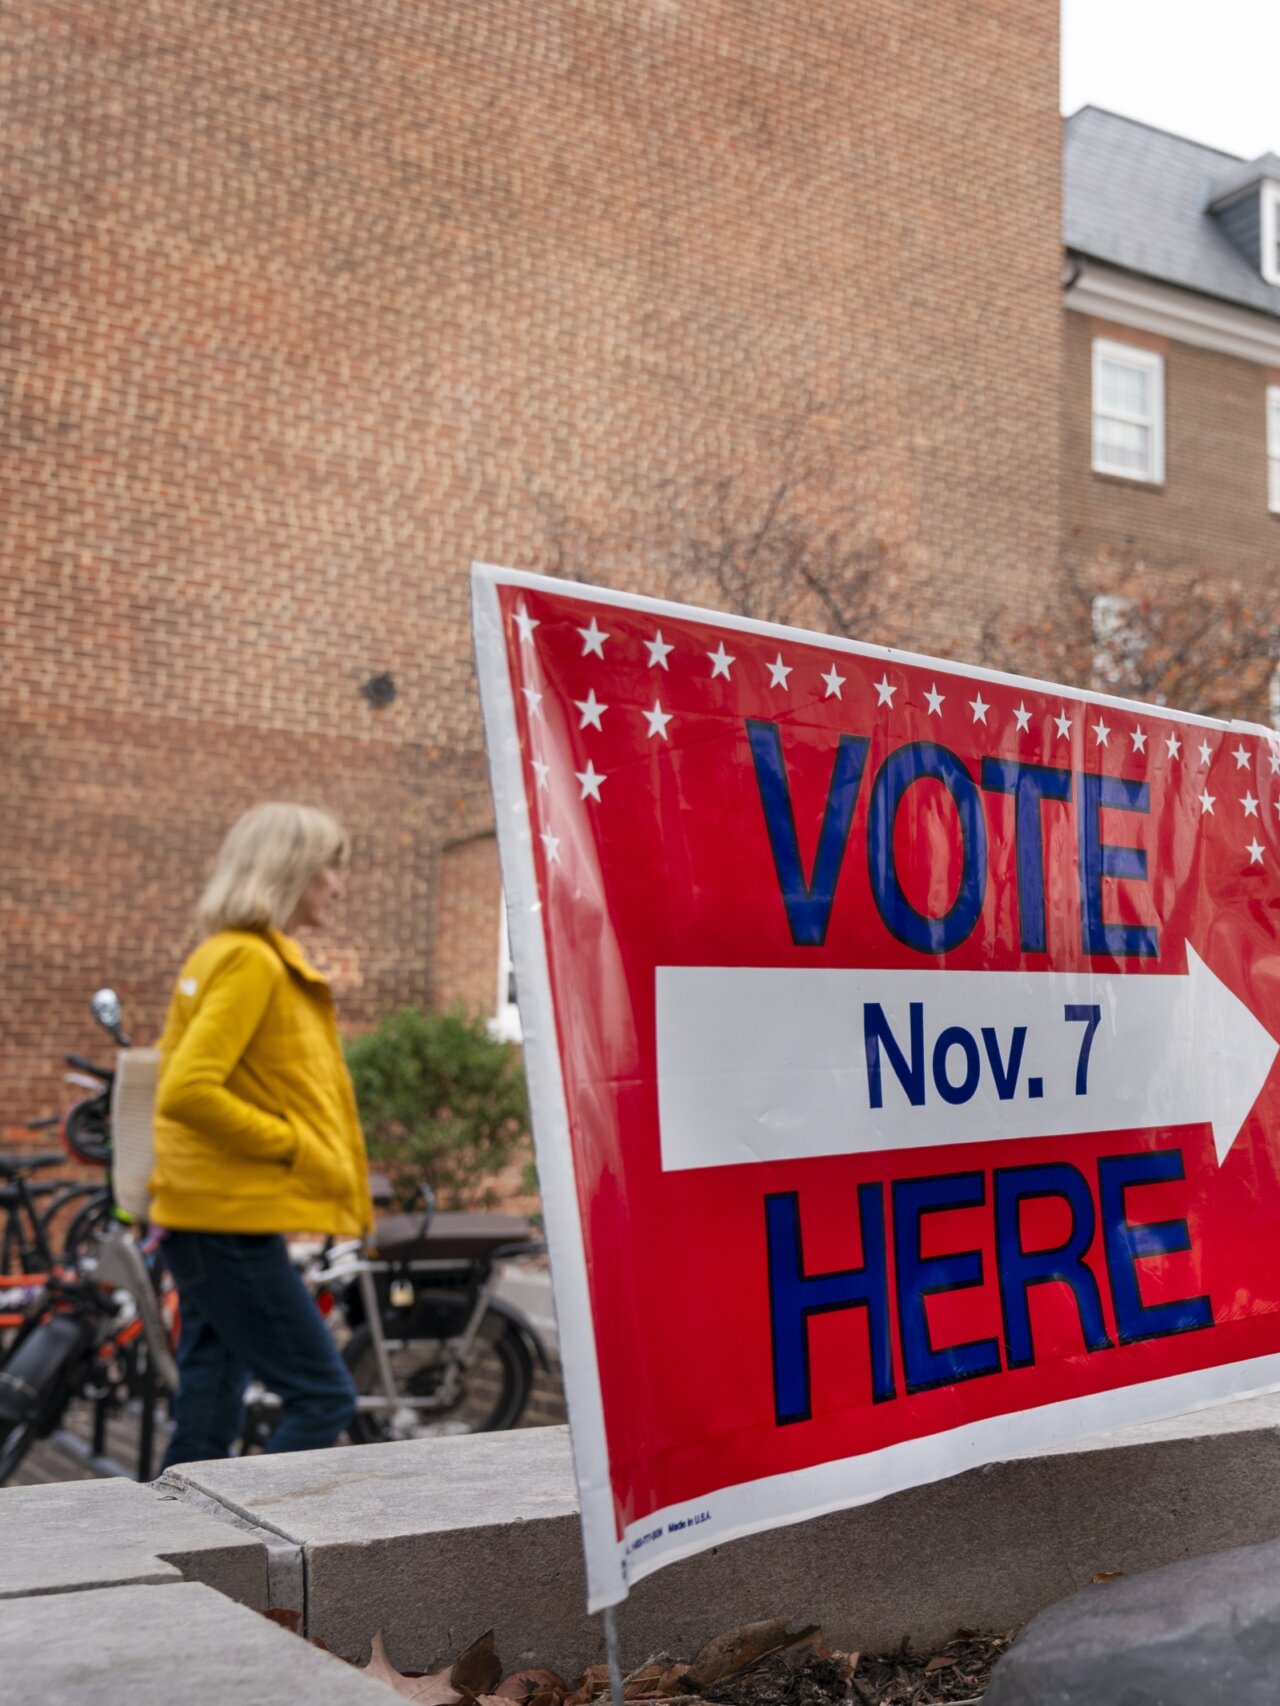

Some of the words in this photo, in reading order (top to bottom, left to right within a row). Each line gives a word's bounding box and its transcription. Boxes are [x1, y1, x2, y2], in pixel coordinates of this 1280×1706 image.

[745, 718, 1158, 958] VOTE
[863, 1003, 1043, 1108] Nov.
[1064, 1004, 1101, 1095] 7
[764, 1148, 1215, 1427] HERE
[668, 1520, 686, 1533] Made
[687, 1518, 693, 1527] in
